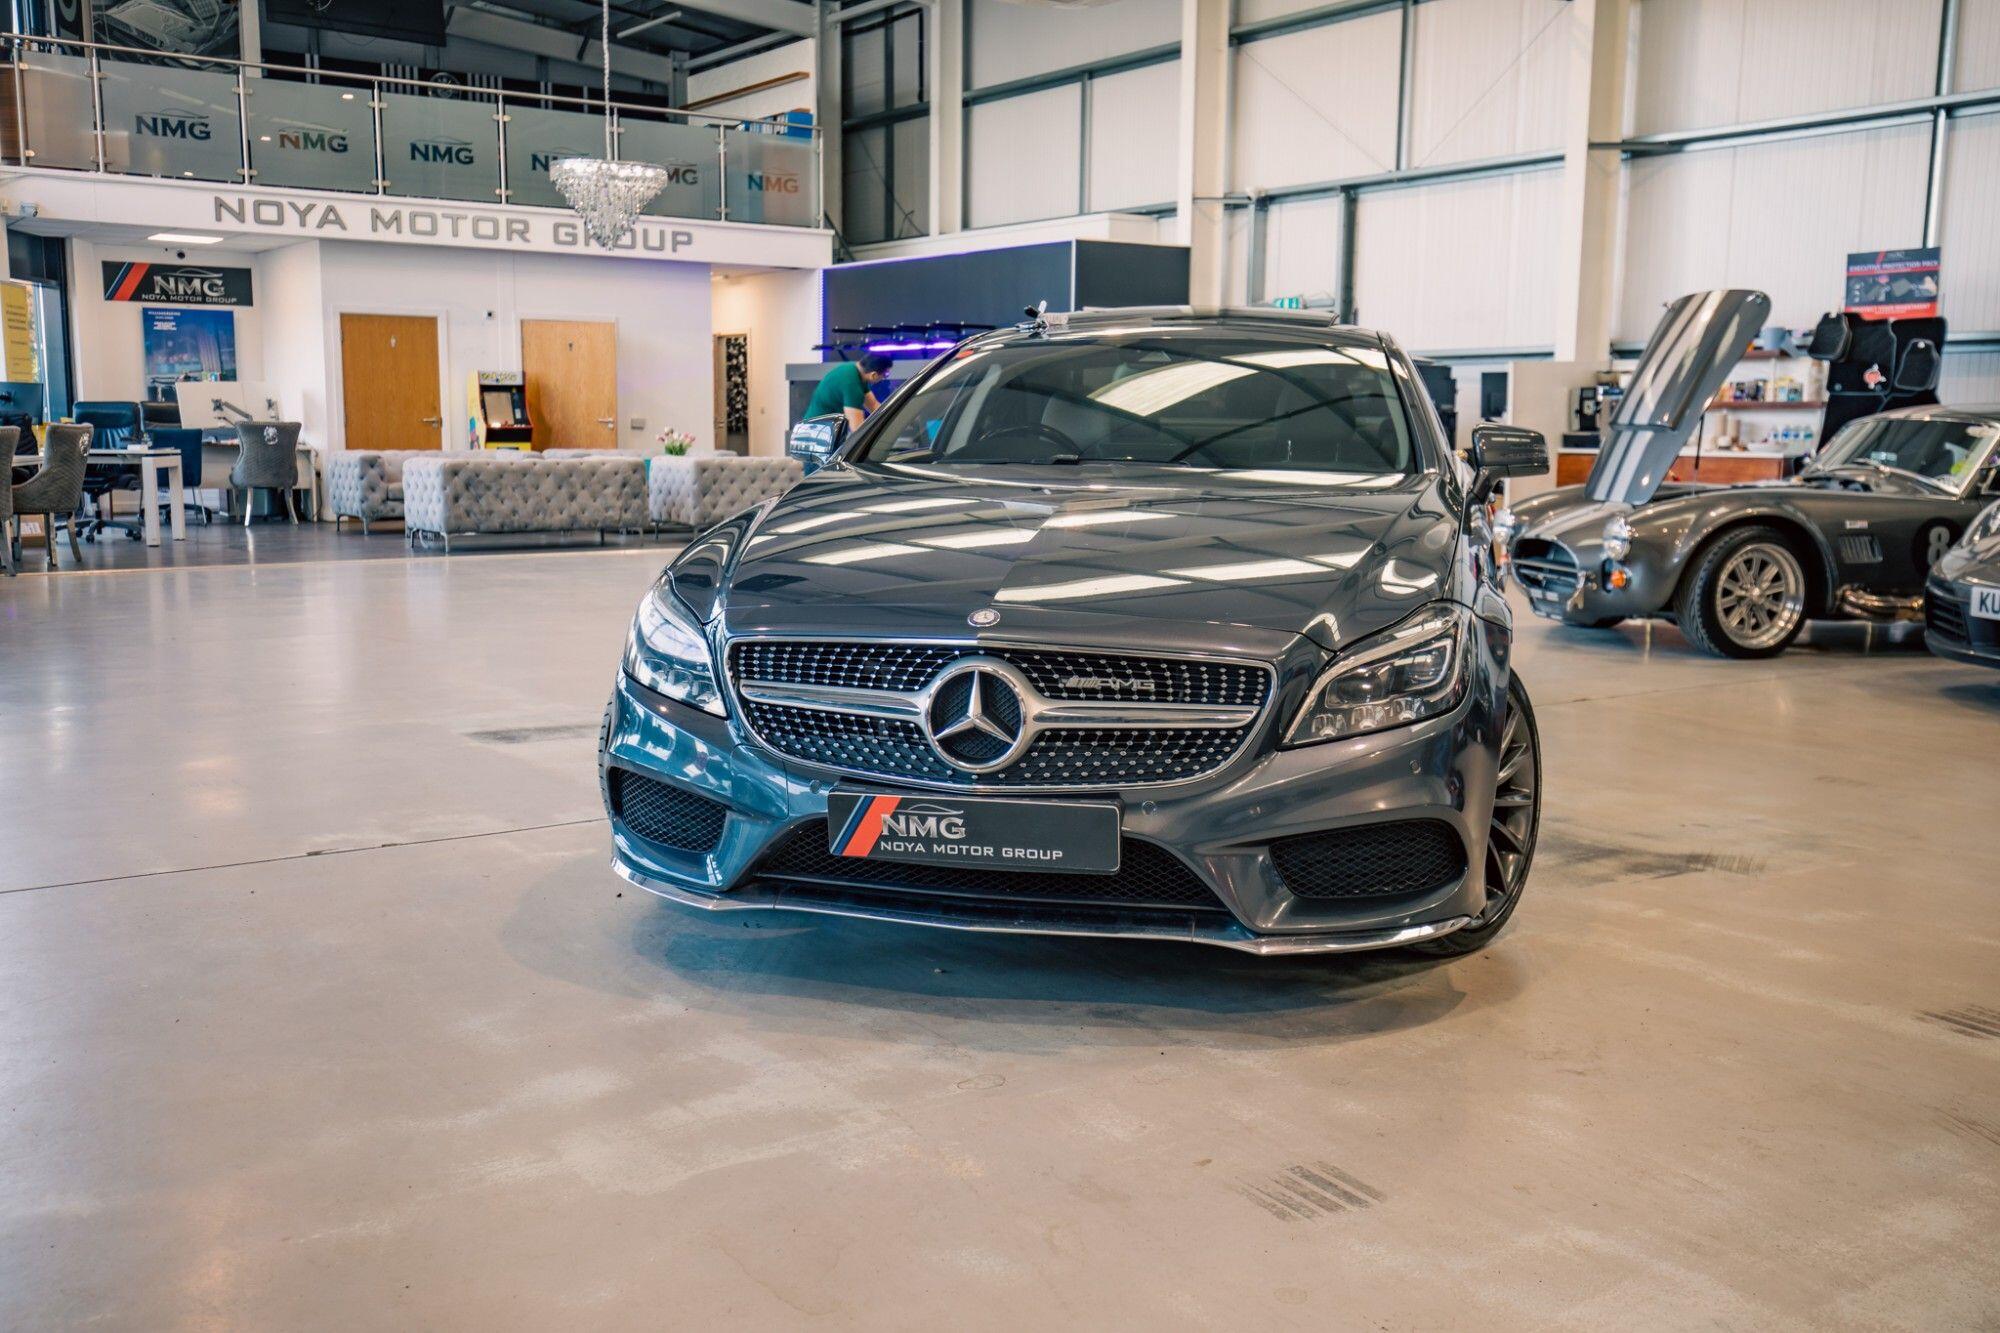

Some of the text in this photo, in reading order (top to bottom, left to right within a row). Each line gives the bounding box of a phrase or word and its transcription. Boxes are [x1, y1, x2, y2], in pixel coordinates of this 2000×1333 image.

[135, 115, 211, 141] NMG
[279, 131, 348, 153] NMG
[410, 142, 474, 165] NMG
[666, 167, 698, 186] MG
[748, 174, 799, 194] NMG
[214, 196, 347, 231] NOYA
[370, 208, 531, 243] MOTOR
[153, 275, 225, 297] NMG
[1928, 526, 1950, 565] 8
[1091, 677, 1155, 691] AMG
[880, 814, 966, 840] NMG
[880, 841, 1063, 860] NOYA MOTOR GROUP
